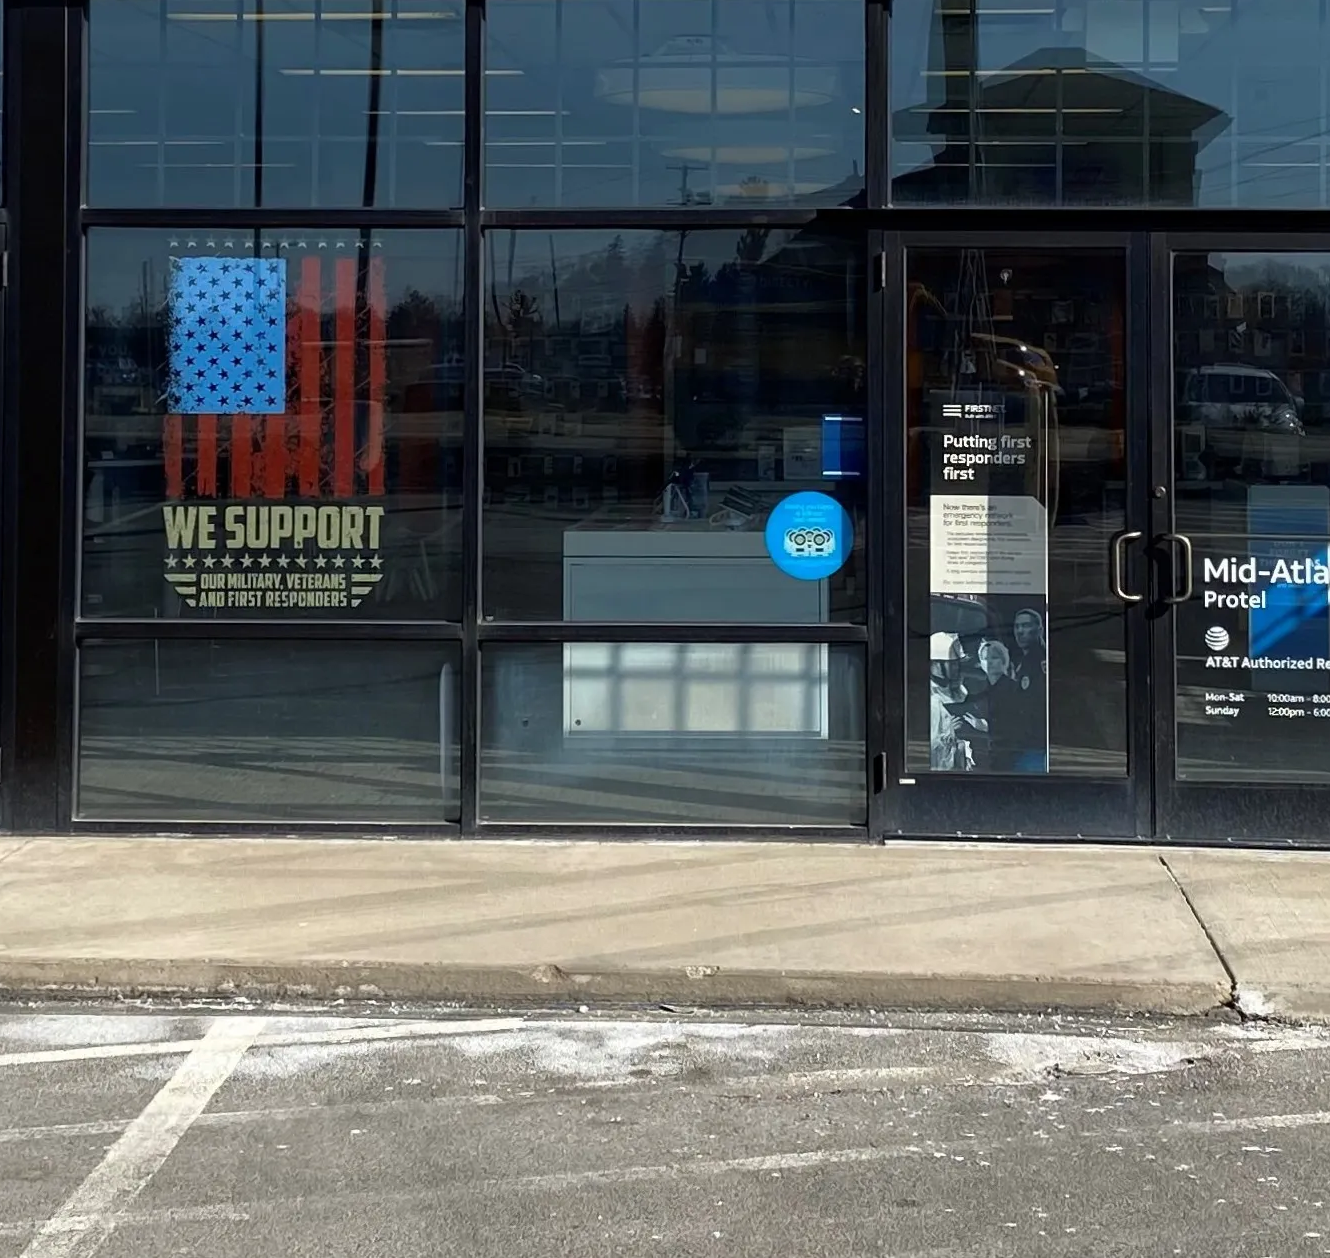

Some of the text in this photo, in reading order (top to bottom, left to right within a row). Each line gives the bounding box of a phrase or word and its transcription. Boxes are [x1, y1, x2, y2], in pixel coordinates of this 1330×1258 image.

[943, 435, 1031, 450] Putting first
[943, 451, 1025, 466] responders
[943, 467, 974, 480] first
[163, 506, 384, 549] WE SUPPORT
[200, 574, 346, 591] OUR MILITARY, VETERANS
[199, 592, 347, 607] AND FIRST RESPONDERS
[1204, 590, 1266, 609] Protel
[1206, 656, 1240, 669] AT&T
[1241, 657, 1314, 670] Authorized
[1205, 693, 1245, 703] Mon-Sat
[1267, 694, 1304, 704] 10:00am
[1205, 705, 1240, 717] Sunday
[1268, 707, 1305, 718] 12:00pm
